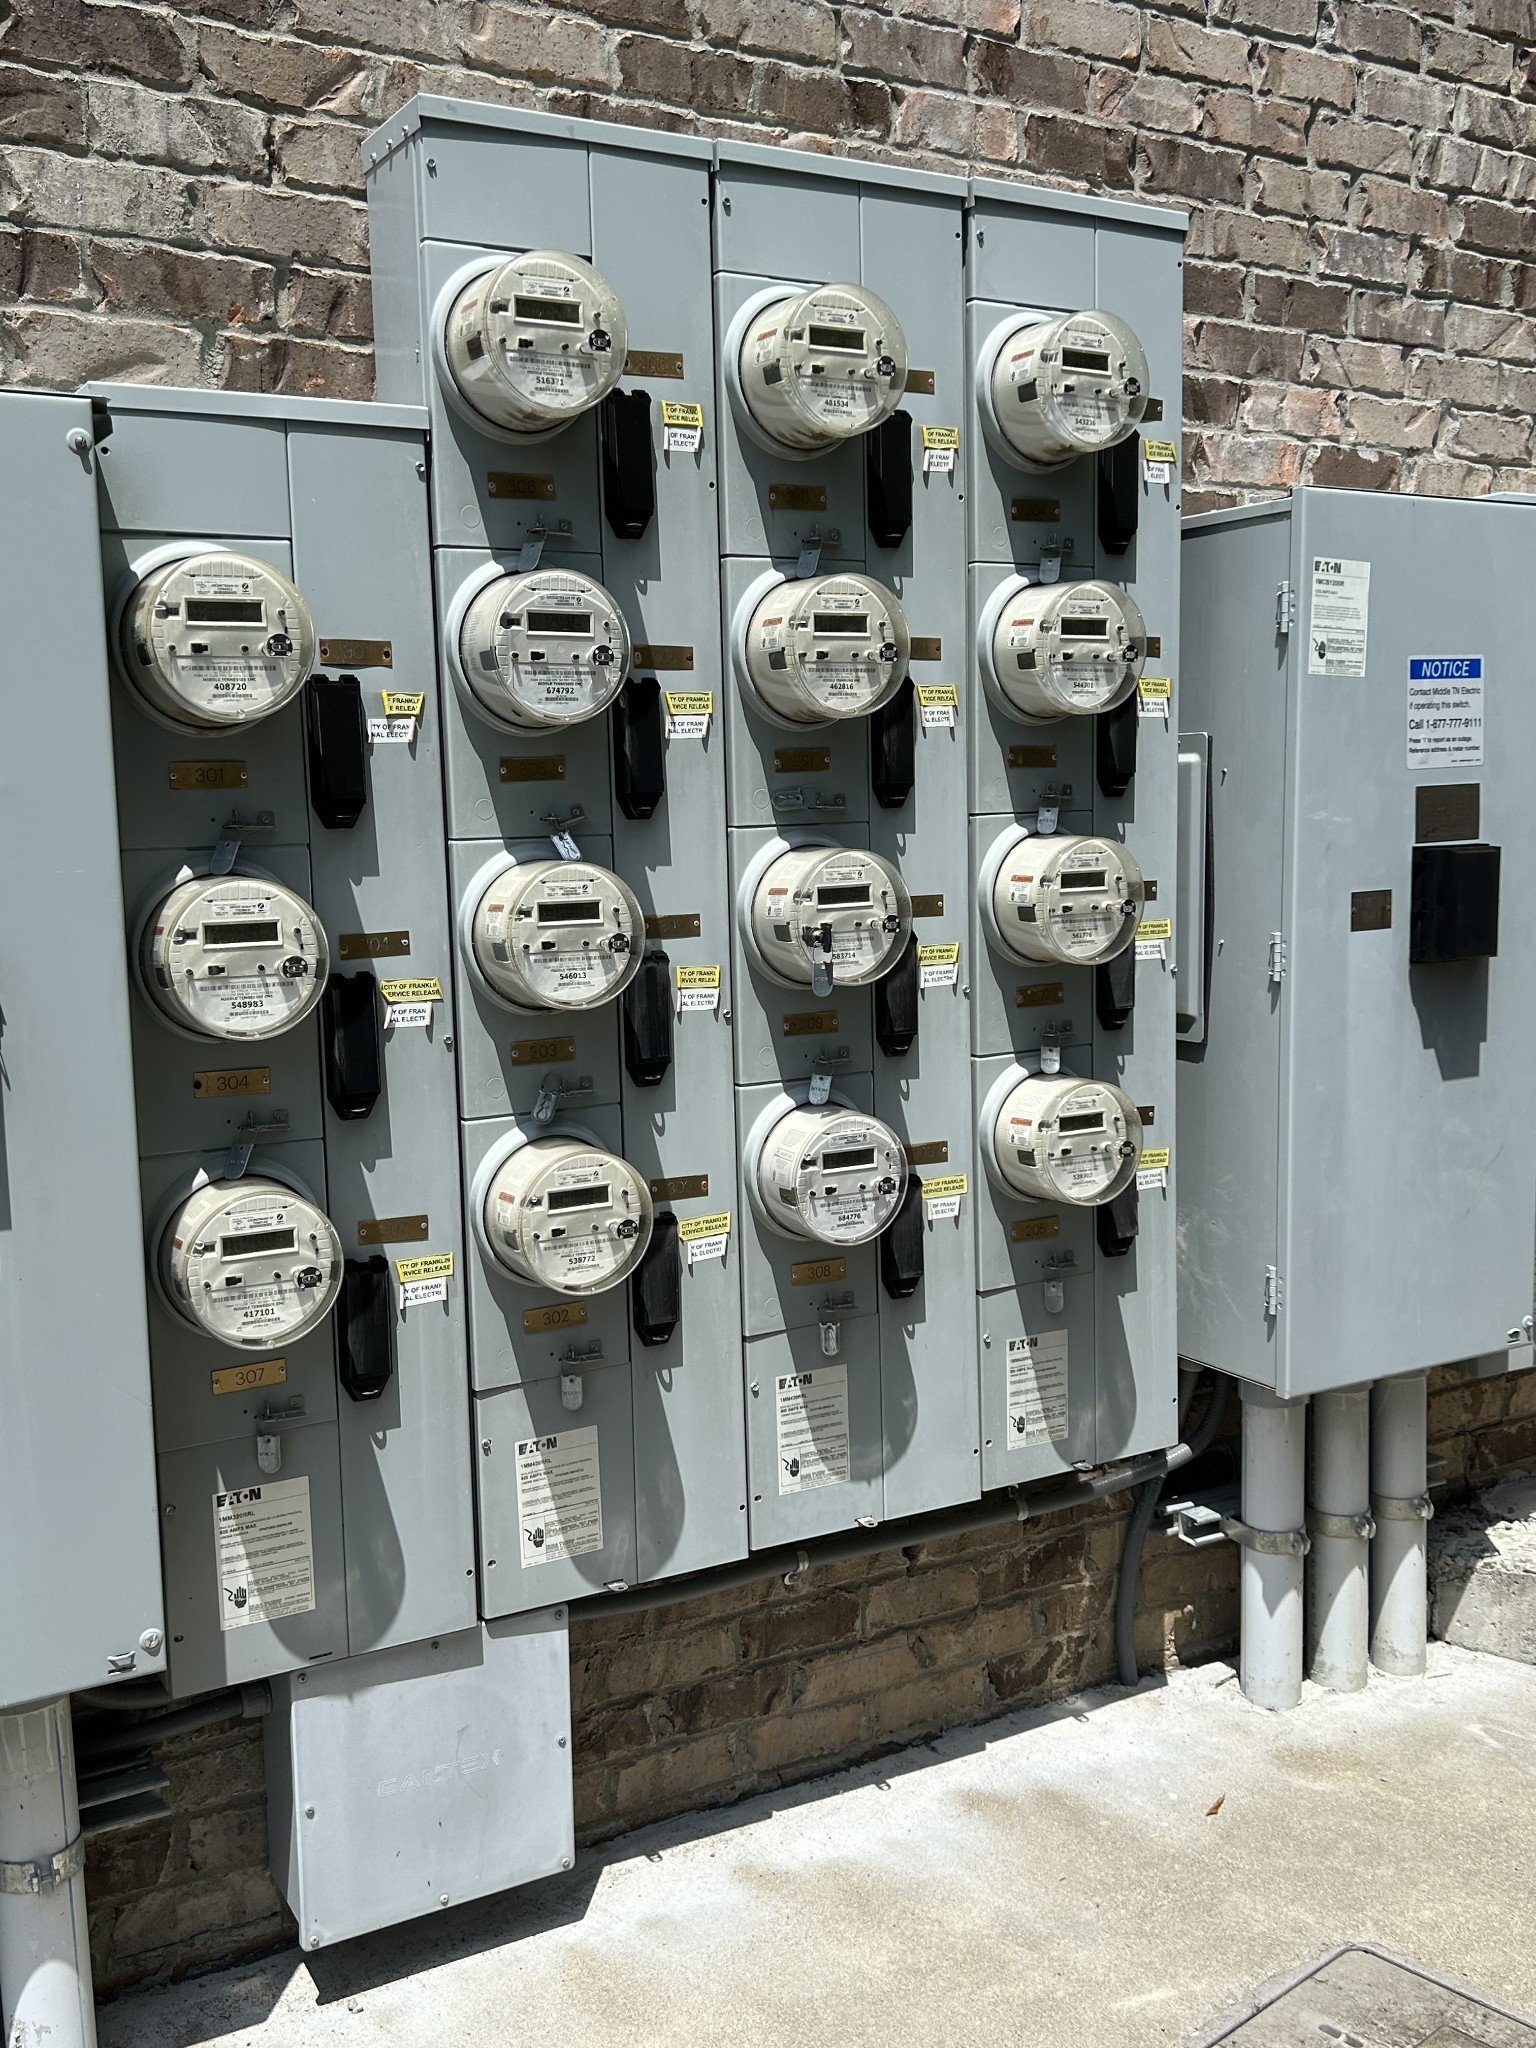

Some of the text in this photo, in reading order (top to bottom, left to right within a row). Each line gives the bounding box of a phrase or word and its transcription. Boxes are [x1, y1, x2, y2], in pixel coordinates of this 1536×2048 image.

[824, 398, 849, 408] 481534
[508, 478, 536, 494] 306
[1314, 560, 1342, 574] EATON
[1421, 661, 1470, 677] NOTICE
[214, 682, 247, 691] 408720
[546, 687, 575, 695] 674792
[1073, 681, 1094, 689] 544301
[1409, 686, 1481, 696] Contact Middle TN Electric
[1413, 701, 1440, 711] operating
[1441, 701, 1451, 709] this
[1409, 717, 1482, 730] Call 1-877-777-9111
[195, 767, 224, 783] 301
[832, 952, 856, 960] 583714
[559, 972, 587, 981] 546013
[231, 1000, 264, 1009] 548983
[217, 1075, 249, 1091] 304
[941, 1178, 964, 1186] FRANKLIN
[681, 1222, 693, 1230] CITY
[702, 1215, 728, 1224] FRANKLIN
[681, 1223, 728, 1236] SERVICE RELEASE
[1025, 1222, 1046, 1237] 205
[420, 1257, 451, 1266] FRANKLIN
[569, 1255, 596, 1265] 538772
[402, 1264, 451, 1276] RVICE RELEASE
[808, 1264, 831, 1280] 308
[243, 1307, 276, 1318] 417101
[542, 1309, 569, 1326] 302
[1008, 1337, 1038, 1352] EATON
[235, 1367, 265, 1386] 307
[778, 1373, 813, 1390] EATON
[518, 1436, 558, 1456] EATON
[216, 1487, 262, 1508] EATON
[230, 1524, 244, 1533] AMPS
[376, 1748, 504, 1798] CANTEX
